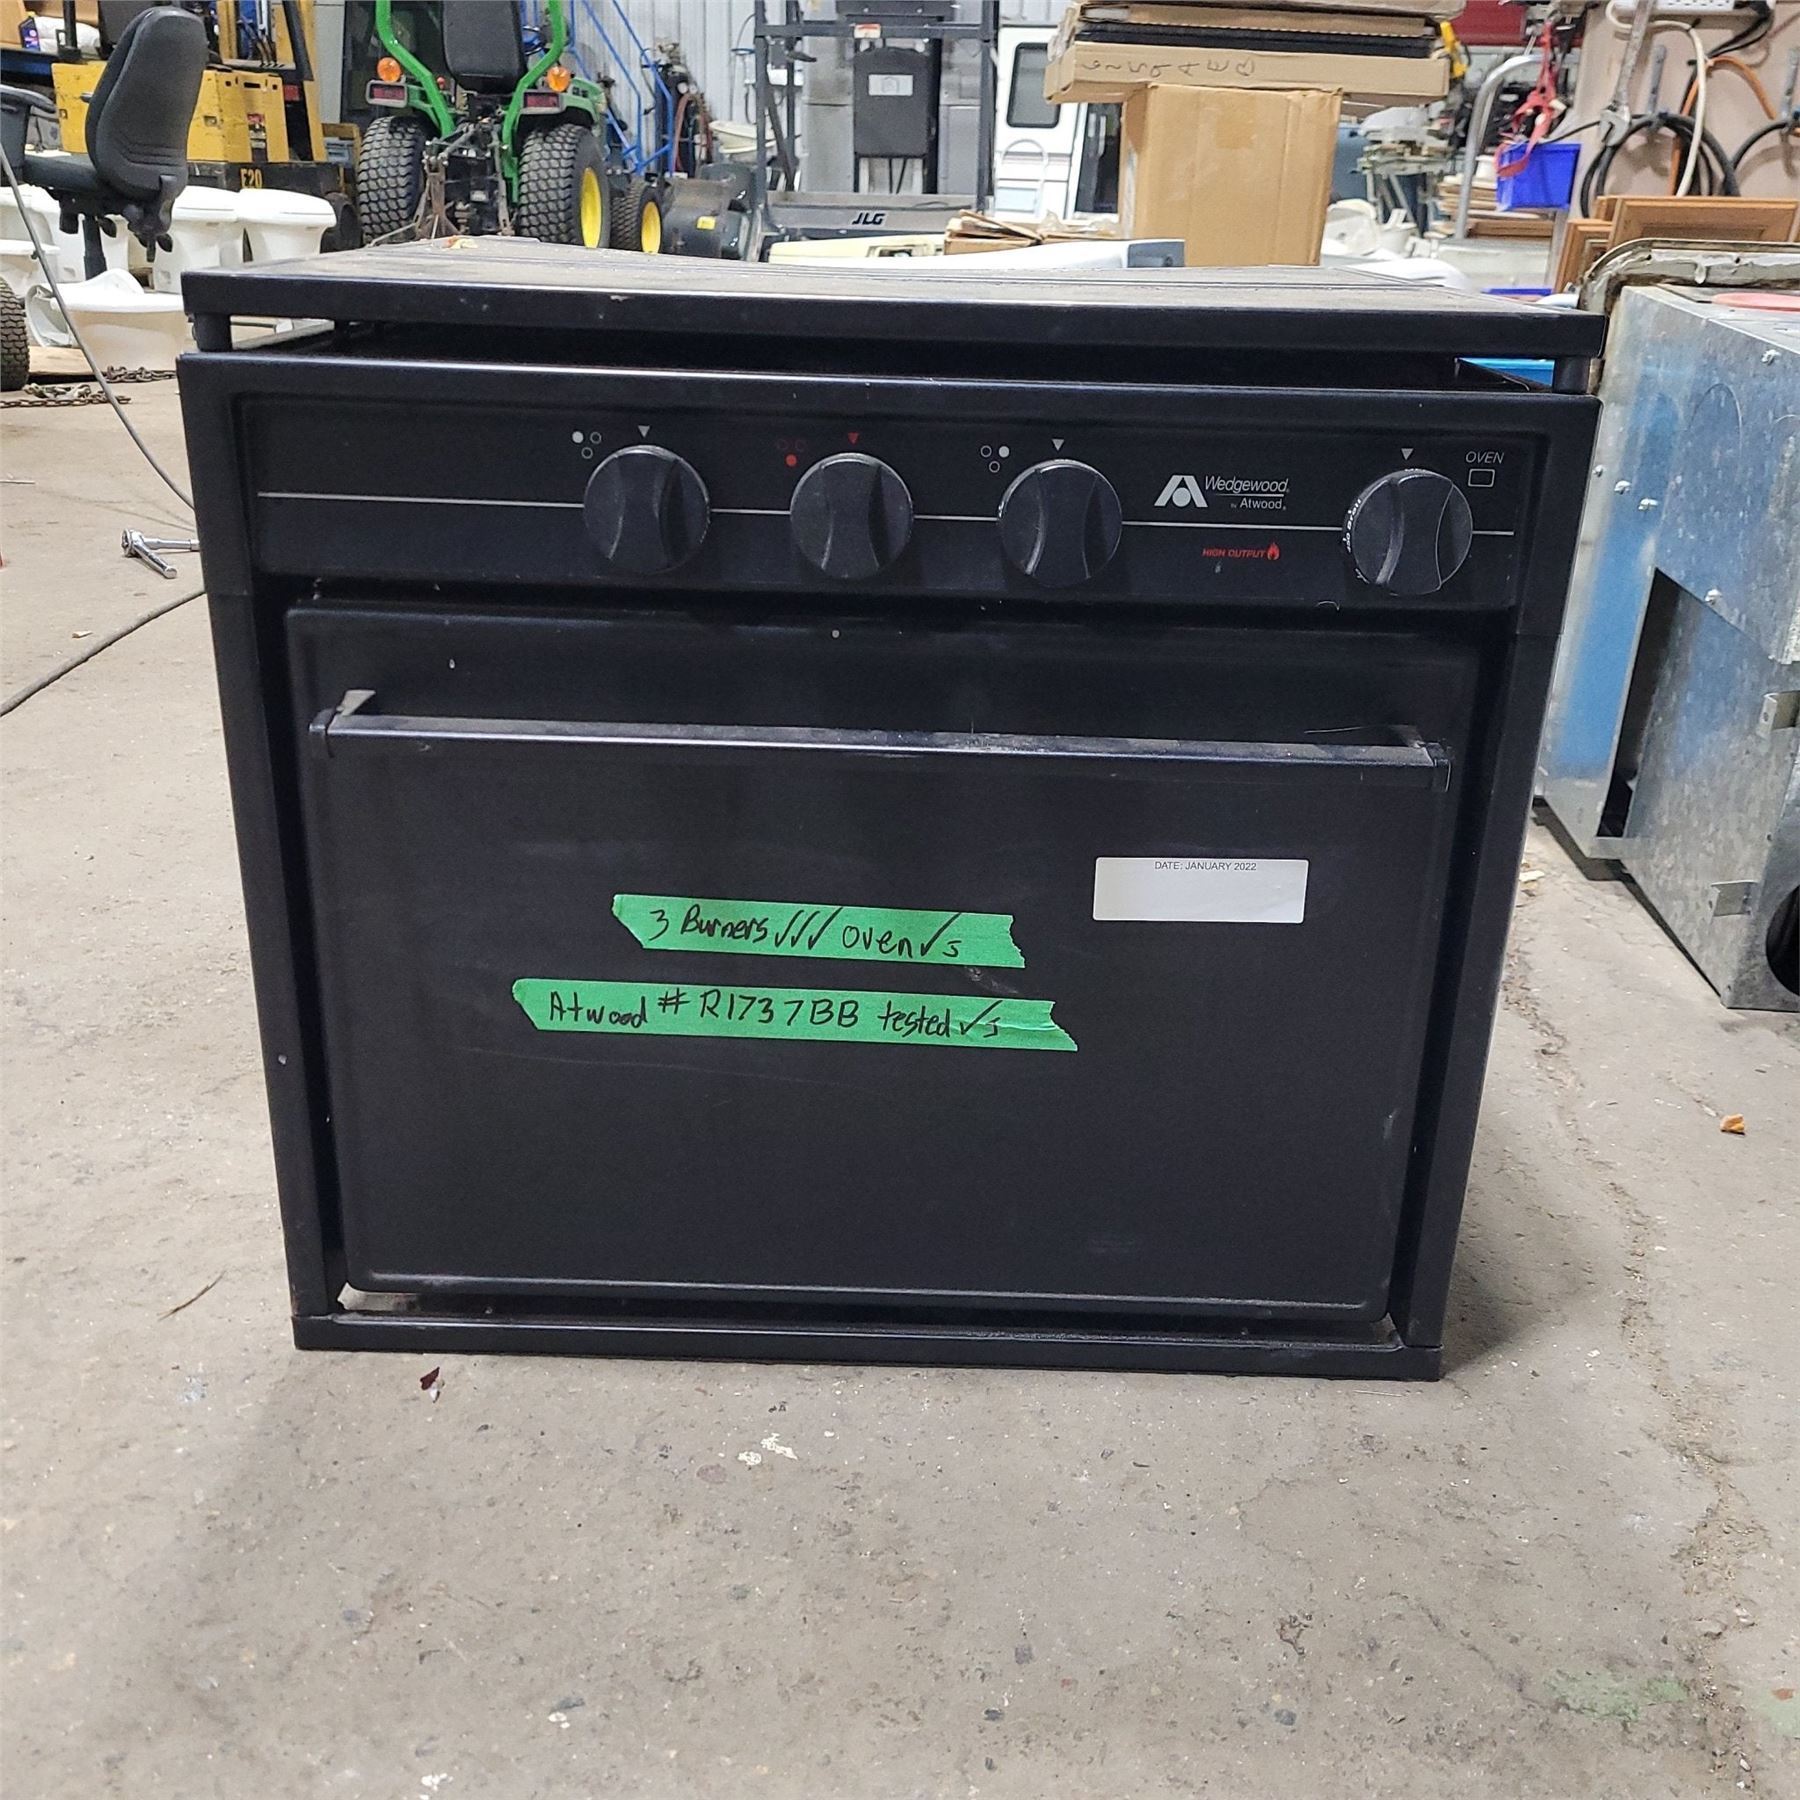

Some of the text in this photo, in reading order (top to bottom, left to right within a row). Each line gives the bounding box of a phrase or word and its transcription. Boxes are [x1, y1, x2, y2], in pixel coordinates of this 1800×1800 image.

[852, 212, 885, 225] JLG
[1465, 450, 1505, 464] OVEN
[1205, 475, 1288, 494] Wedgewood
[1239, 497, 1282, 510] Atwood
[1202, 547, 1267, 559] HIGH OUTPUT
[1155, 861, 1257, 871] DATE: JANUARY 2022
[649, 909, 670, 942] 3
[680, 903, 769, 944] Burners
[550, 990, 649, 1029] Atwood
[877, 1000, 950, 1038] tested
